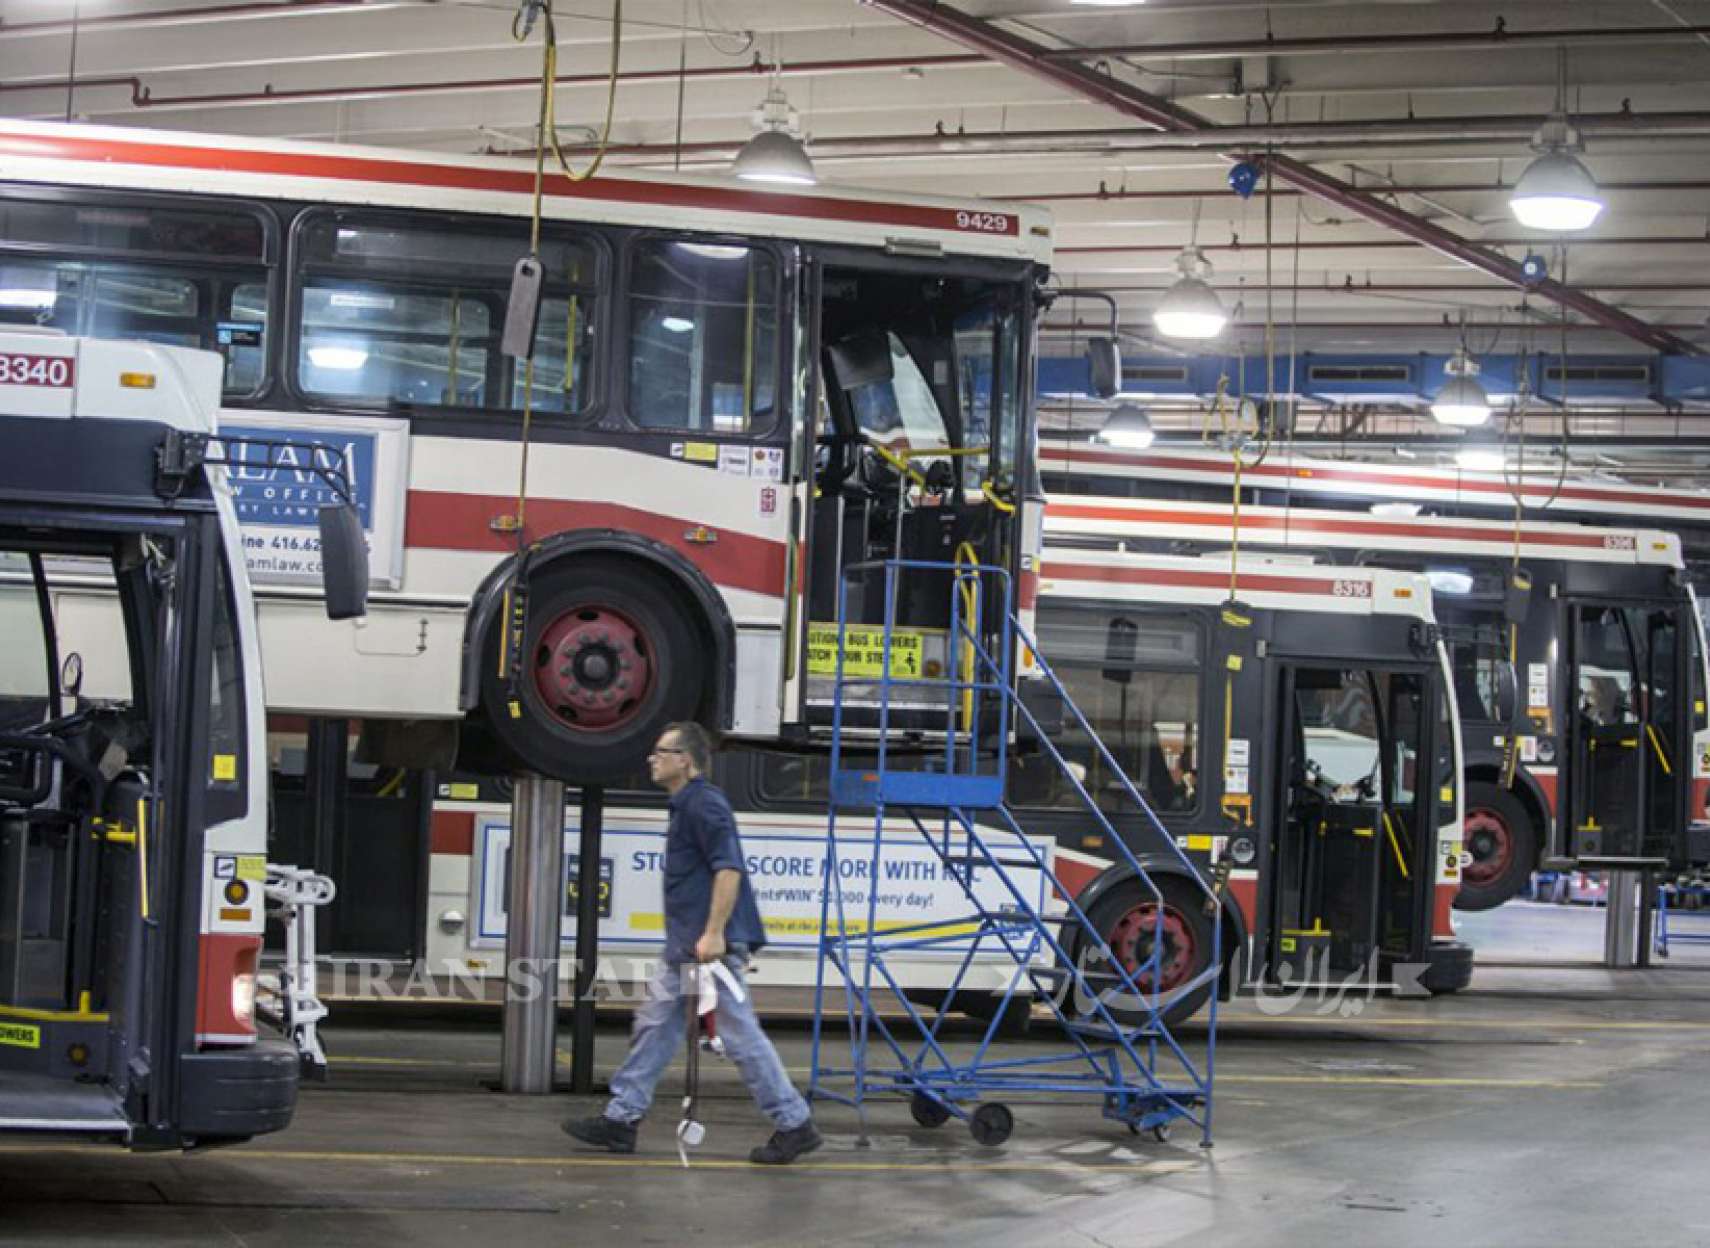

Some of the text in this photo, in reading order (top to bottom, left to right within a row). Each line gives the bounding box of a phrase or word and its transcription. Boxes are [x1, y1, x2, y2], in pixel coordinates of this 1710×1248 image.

[956, 211, 1008, 232] 9429
[225, 437, 356, 486] LAM
[246, 556, 323, 573] amlaw.co
[746, 856, 814, 876] SCORE
[885, 860, 936, 881] WITH
